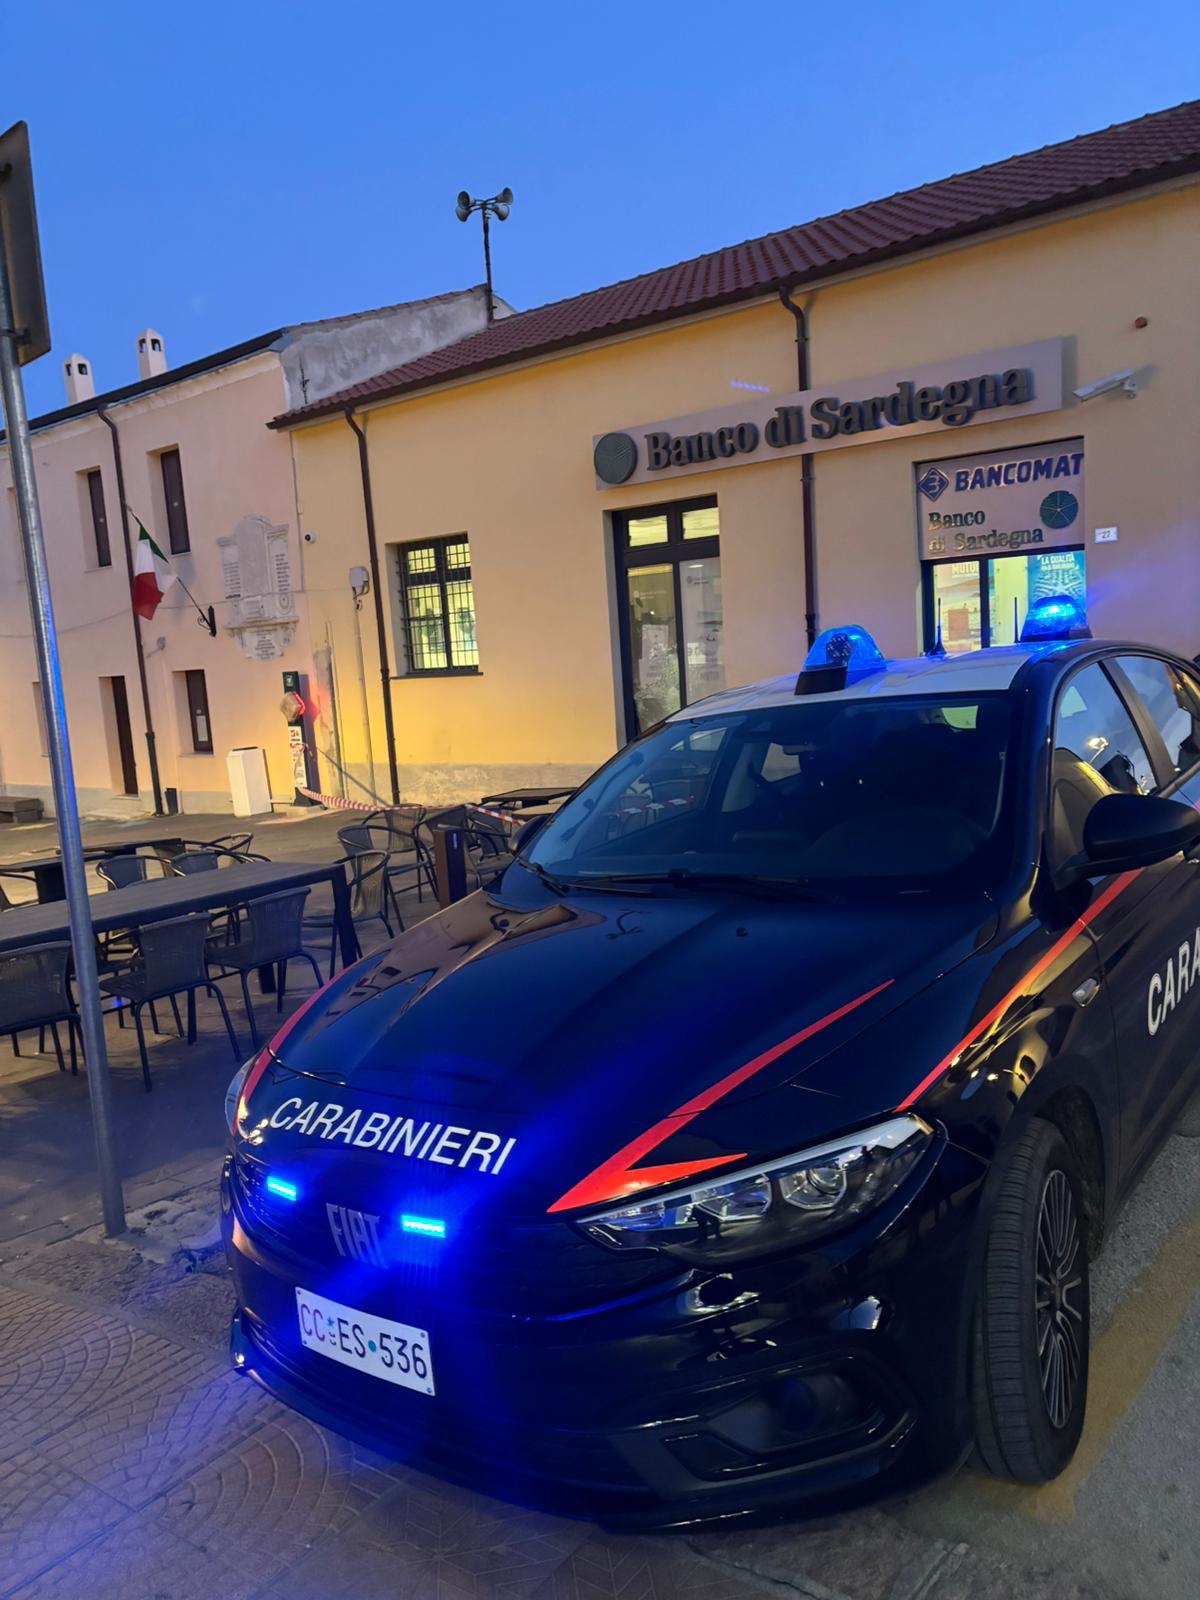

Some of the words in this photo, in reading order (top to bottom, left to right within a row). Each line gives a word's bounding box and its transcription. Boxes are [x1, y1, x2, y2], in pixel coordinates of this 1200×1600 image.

[645, 422, 760, 471] Banco
[764, 405, 807, 448] di
[810, 367, 1036, 439] Sardegna
[955, 453, 1084, 492] BANCOMAT
[928, 510, 986, 532] Banco
[928, 536, 946, 552] di
[954, 528, 1044, 550] Sardegna
[269, 1097, 517, 1175] CARABINIERI
[325, 1202, 388, 1269] FIAT
